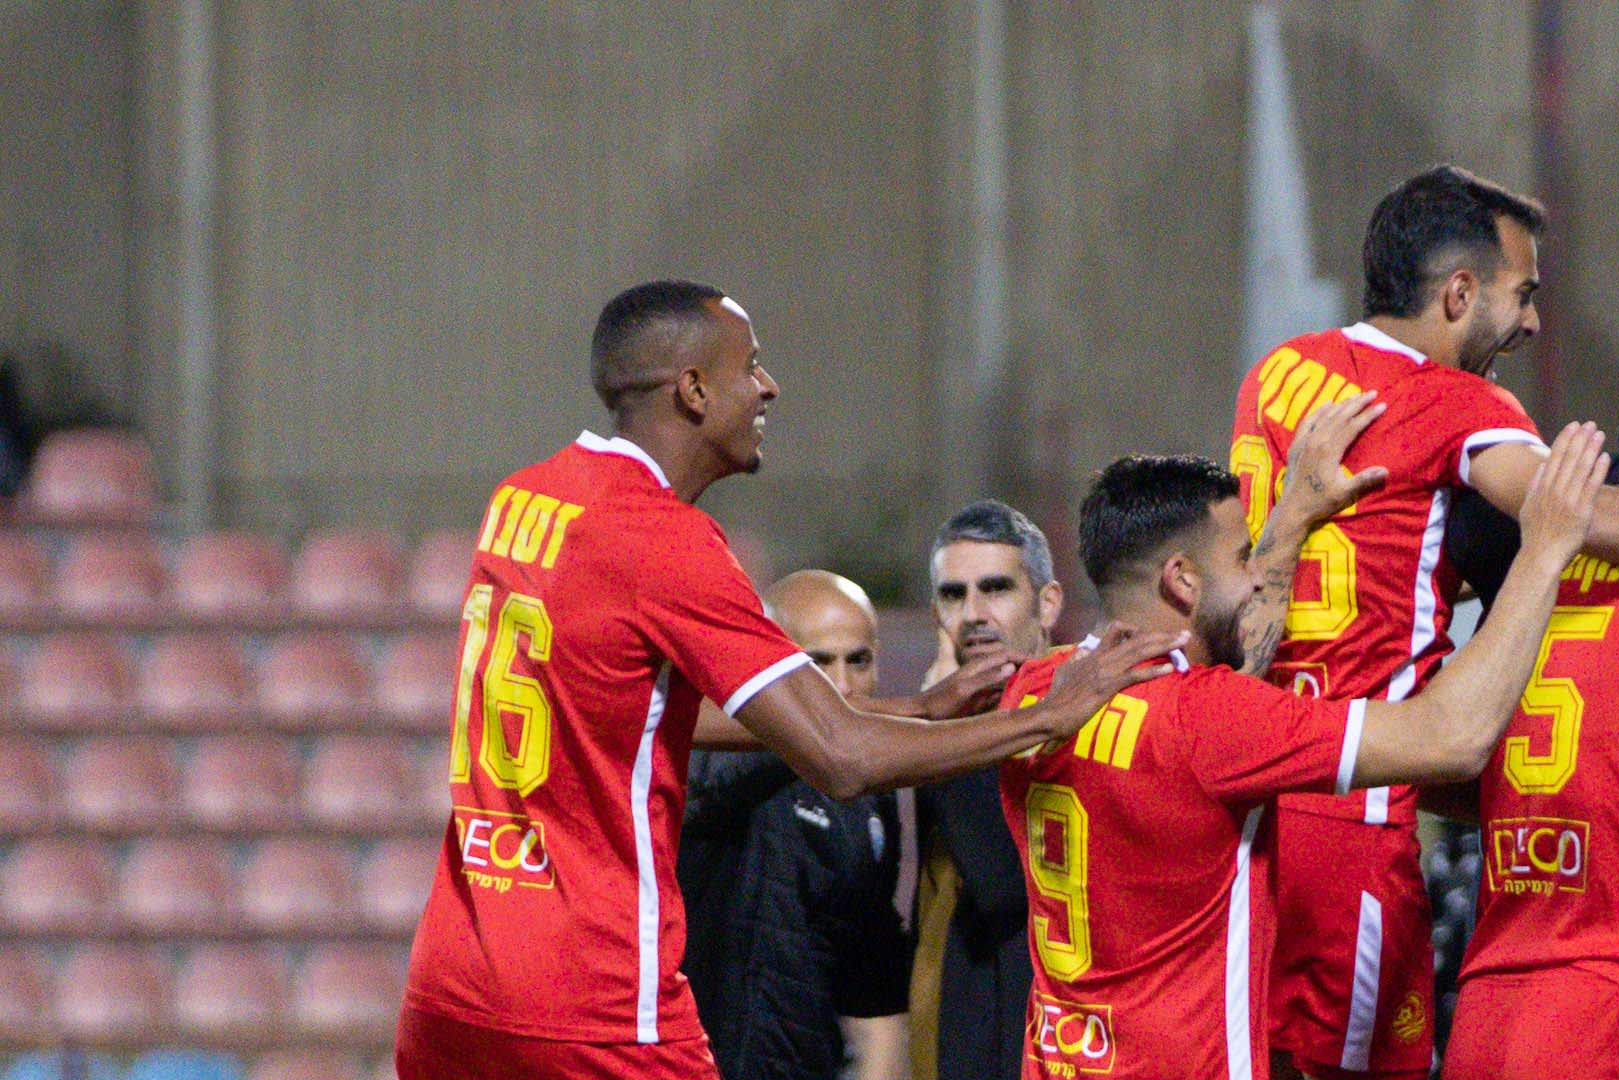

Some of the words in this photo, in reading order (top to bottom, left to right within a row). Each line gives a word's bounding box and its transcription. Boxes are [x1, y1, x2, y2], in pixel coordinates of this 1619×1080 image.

[449, 583, 553, 798] 16
[1503, 605, 1615, 794] 5
[1025, 782, 1093, 982] 9
[1494, 827, 1581, 875] DECO
